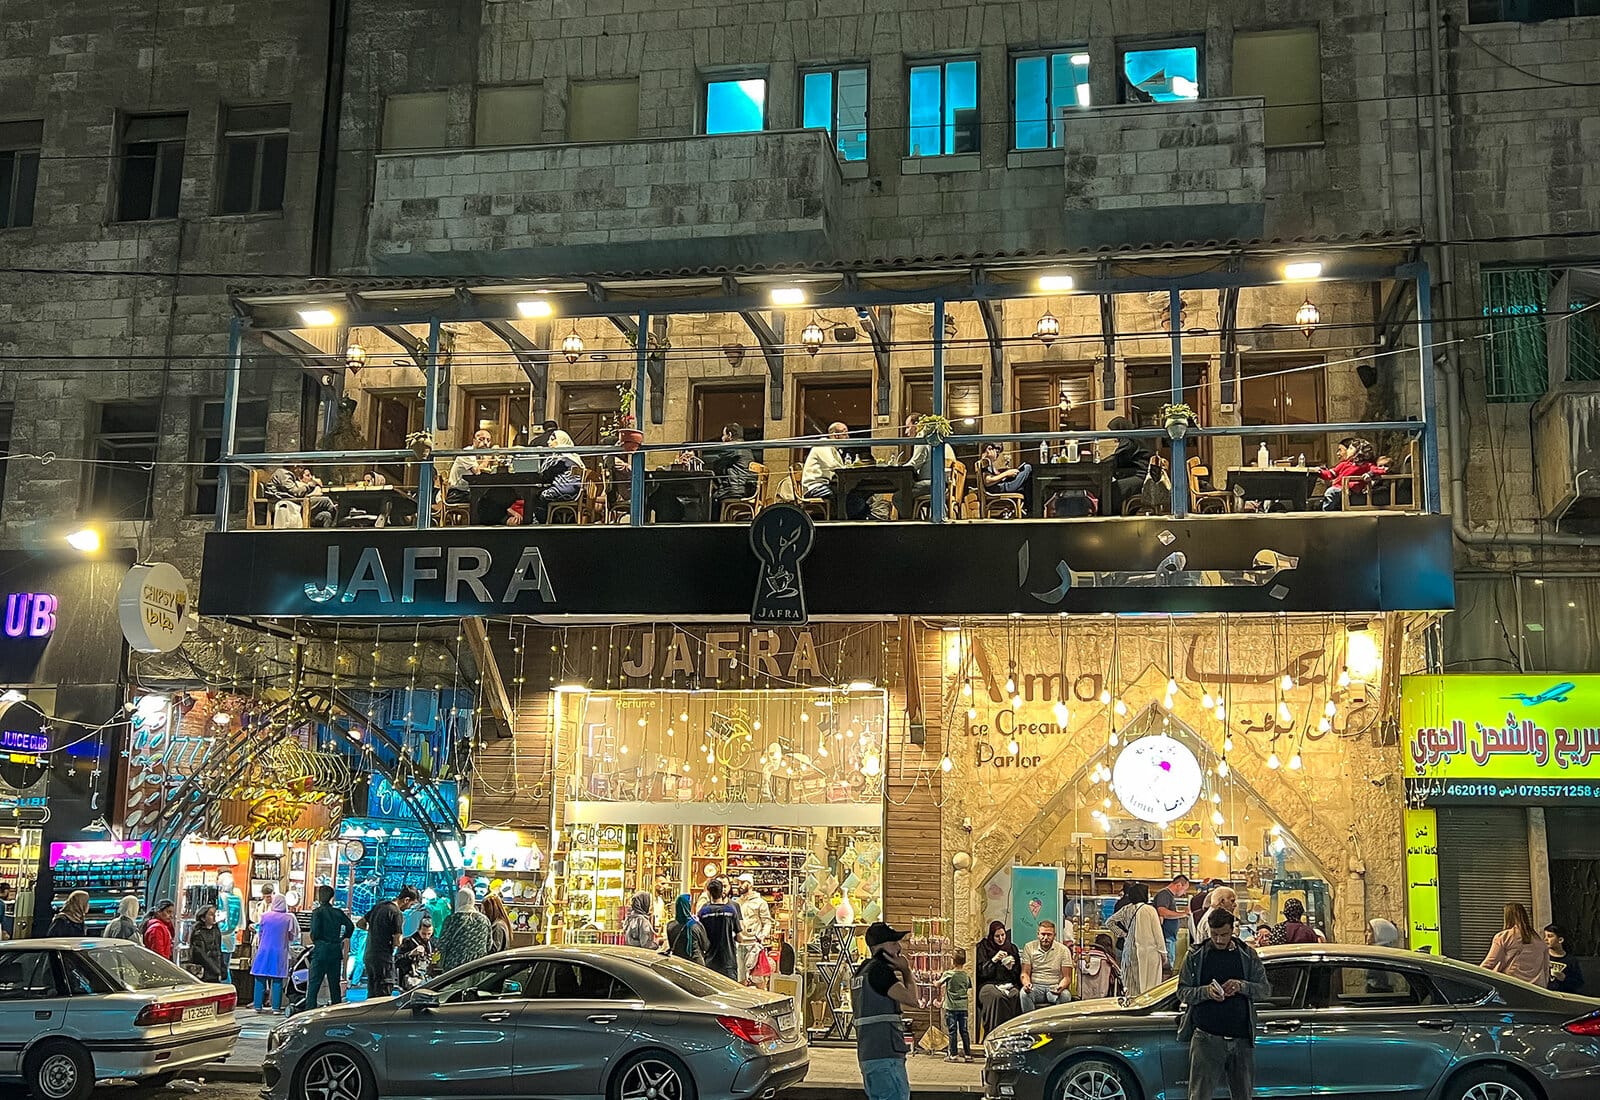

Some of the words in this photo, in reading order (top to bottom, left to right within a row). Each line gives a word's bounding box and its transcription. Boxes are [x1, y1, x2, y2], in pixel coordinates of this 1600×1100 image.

[304, 545, 557, 603] JAFRA
[1018, 529, 1299, 605] جفرا
[146, 607, 174, 634] بطاطا
[758, 606, 800, 619] JAFRA
[622, 630, 822, 678] JAFRA
[616, 699, 656, 709] Perfume
[964, 711, 988, 736] Ice
[995, 709, 1067, 737] Cream
[1240, 712, 1296, 742] بوظة
[0, 731, 30, 749] JUICE
[1410, 719, 1466, 775] الجوي
[1471, 711, 1549, 766] والشحن
[977, 741, 1041, 768] Parlor
[1447, 784, 1497, 797] 4620119
[1519, 784, 1592, 797] 0795571258
